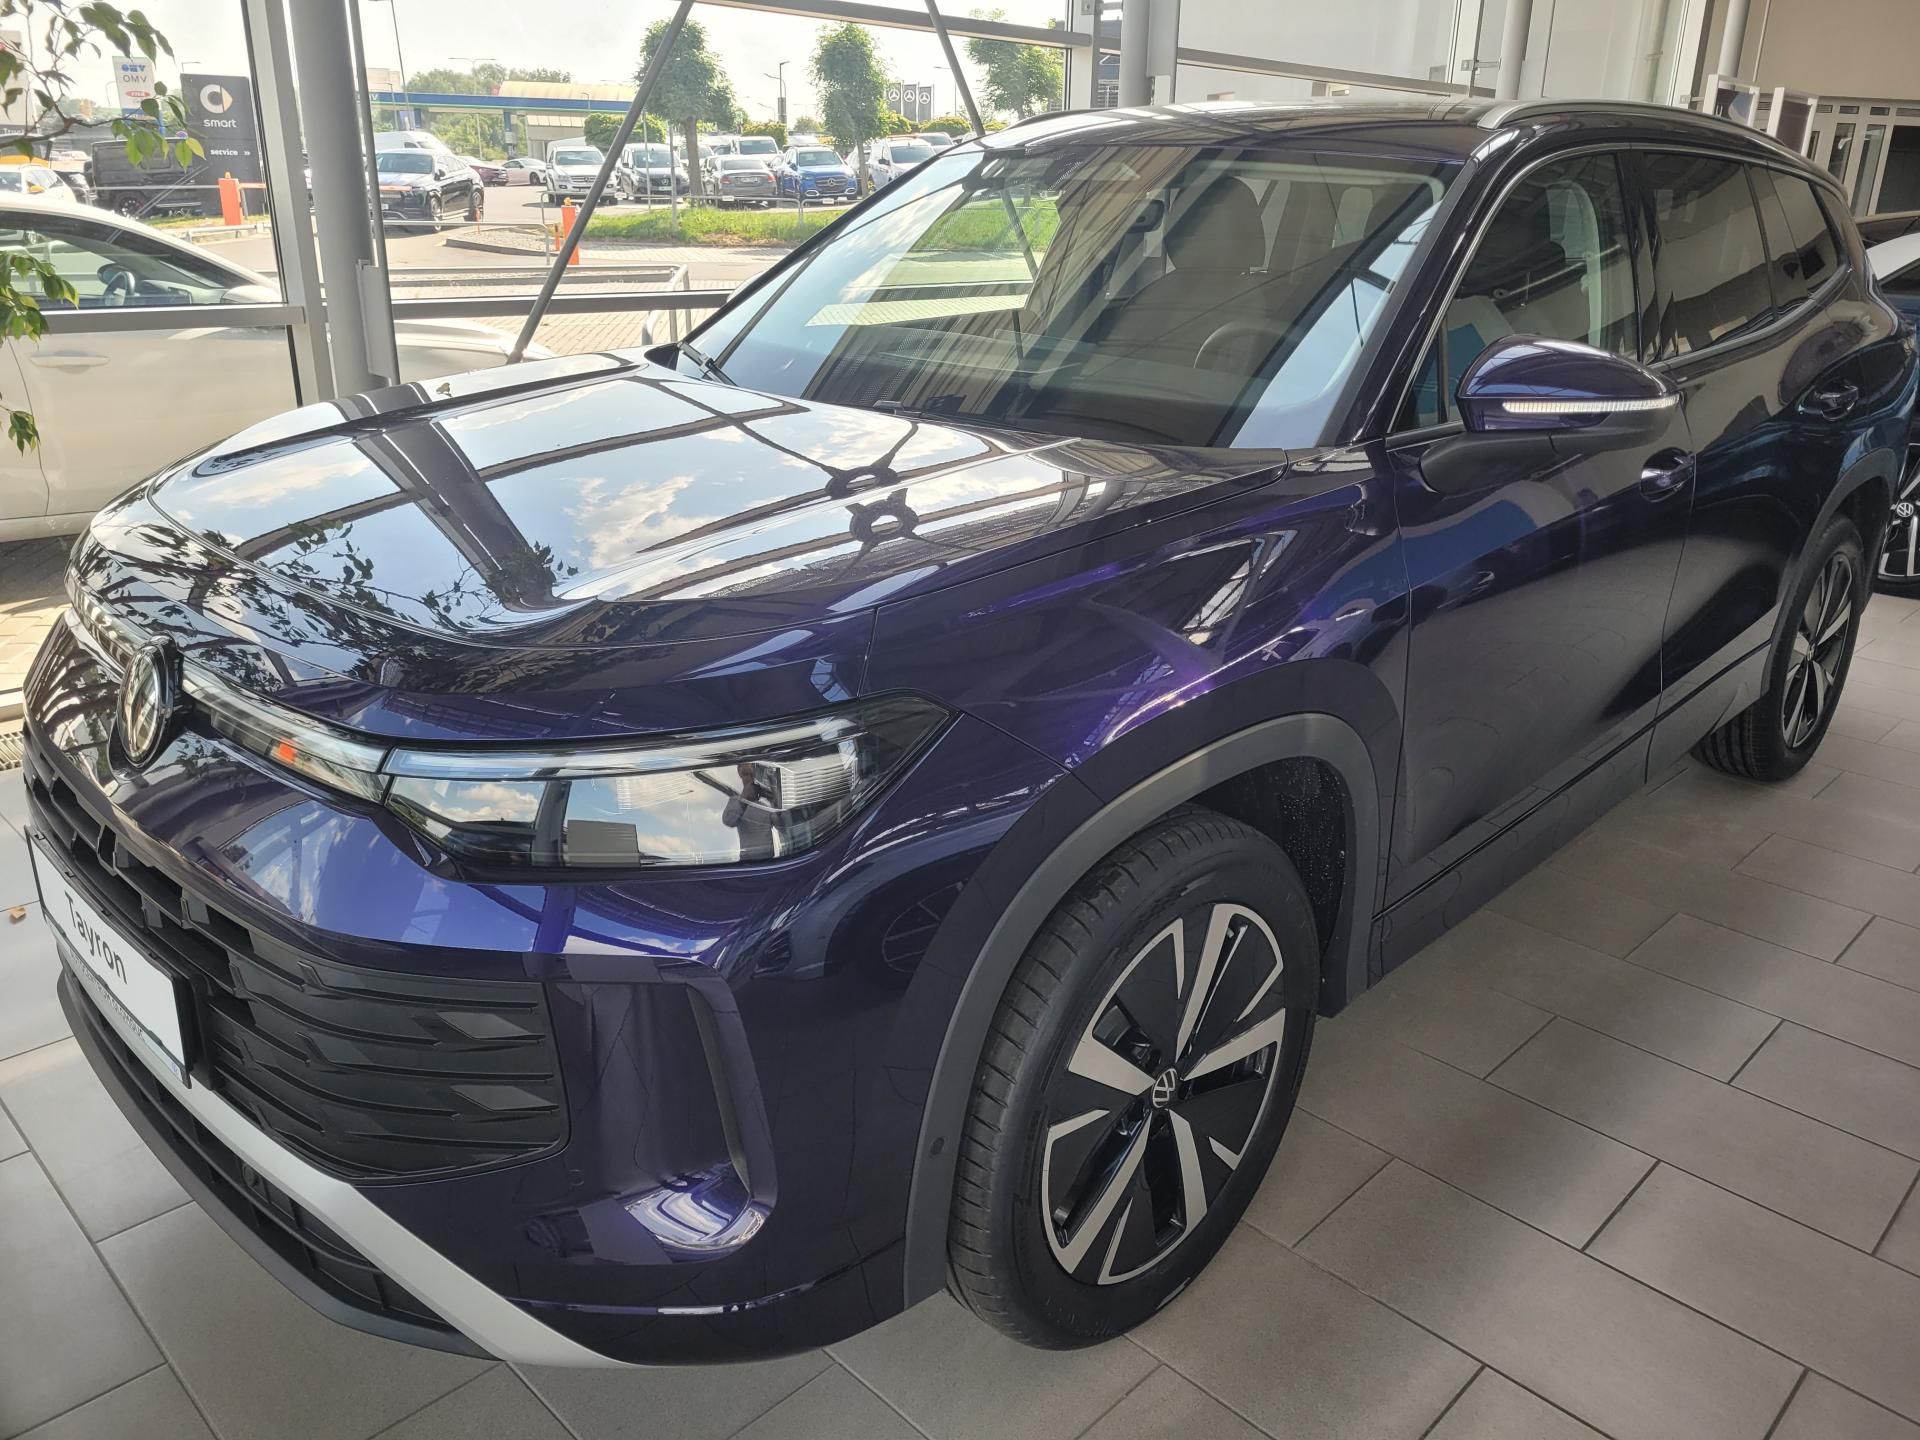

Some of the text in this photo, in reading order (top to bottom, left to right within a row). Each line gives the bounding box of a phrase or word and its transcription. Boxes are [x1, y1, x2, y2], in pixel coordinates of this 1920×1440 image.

[122, 74, 147, 83] OMV
[203, 118, 237, 128] smart
[210, 148, 239, 156] service
[64, 890, 127, 985] Tayron
